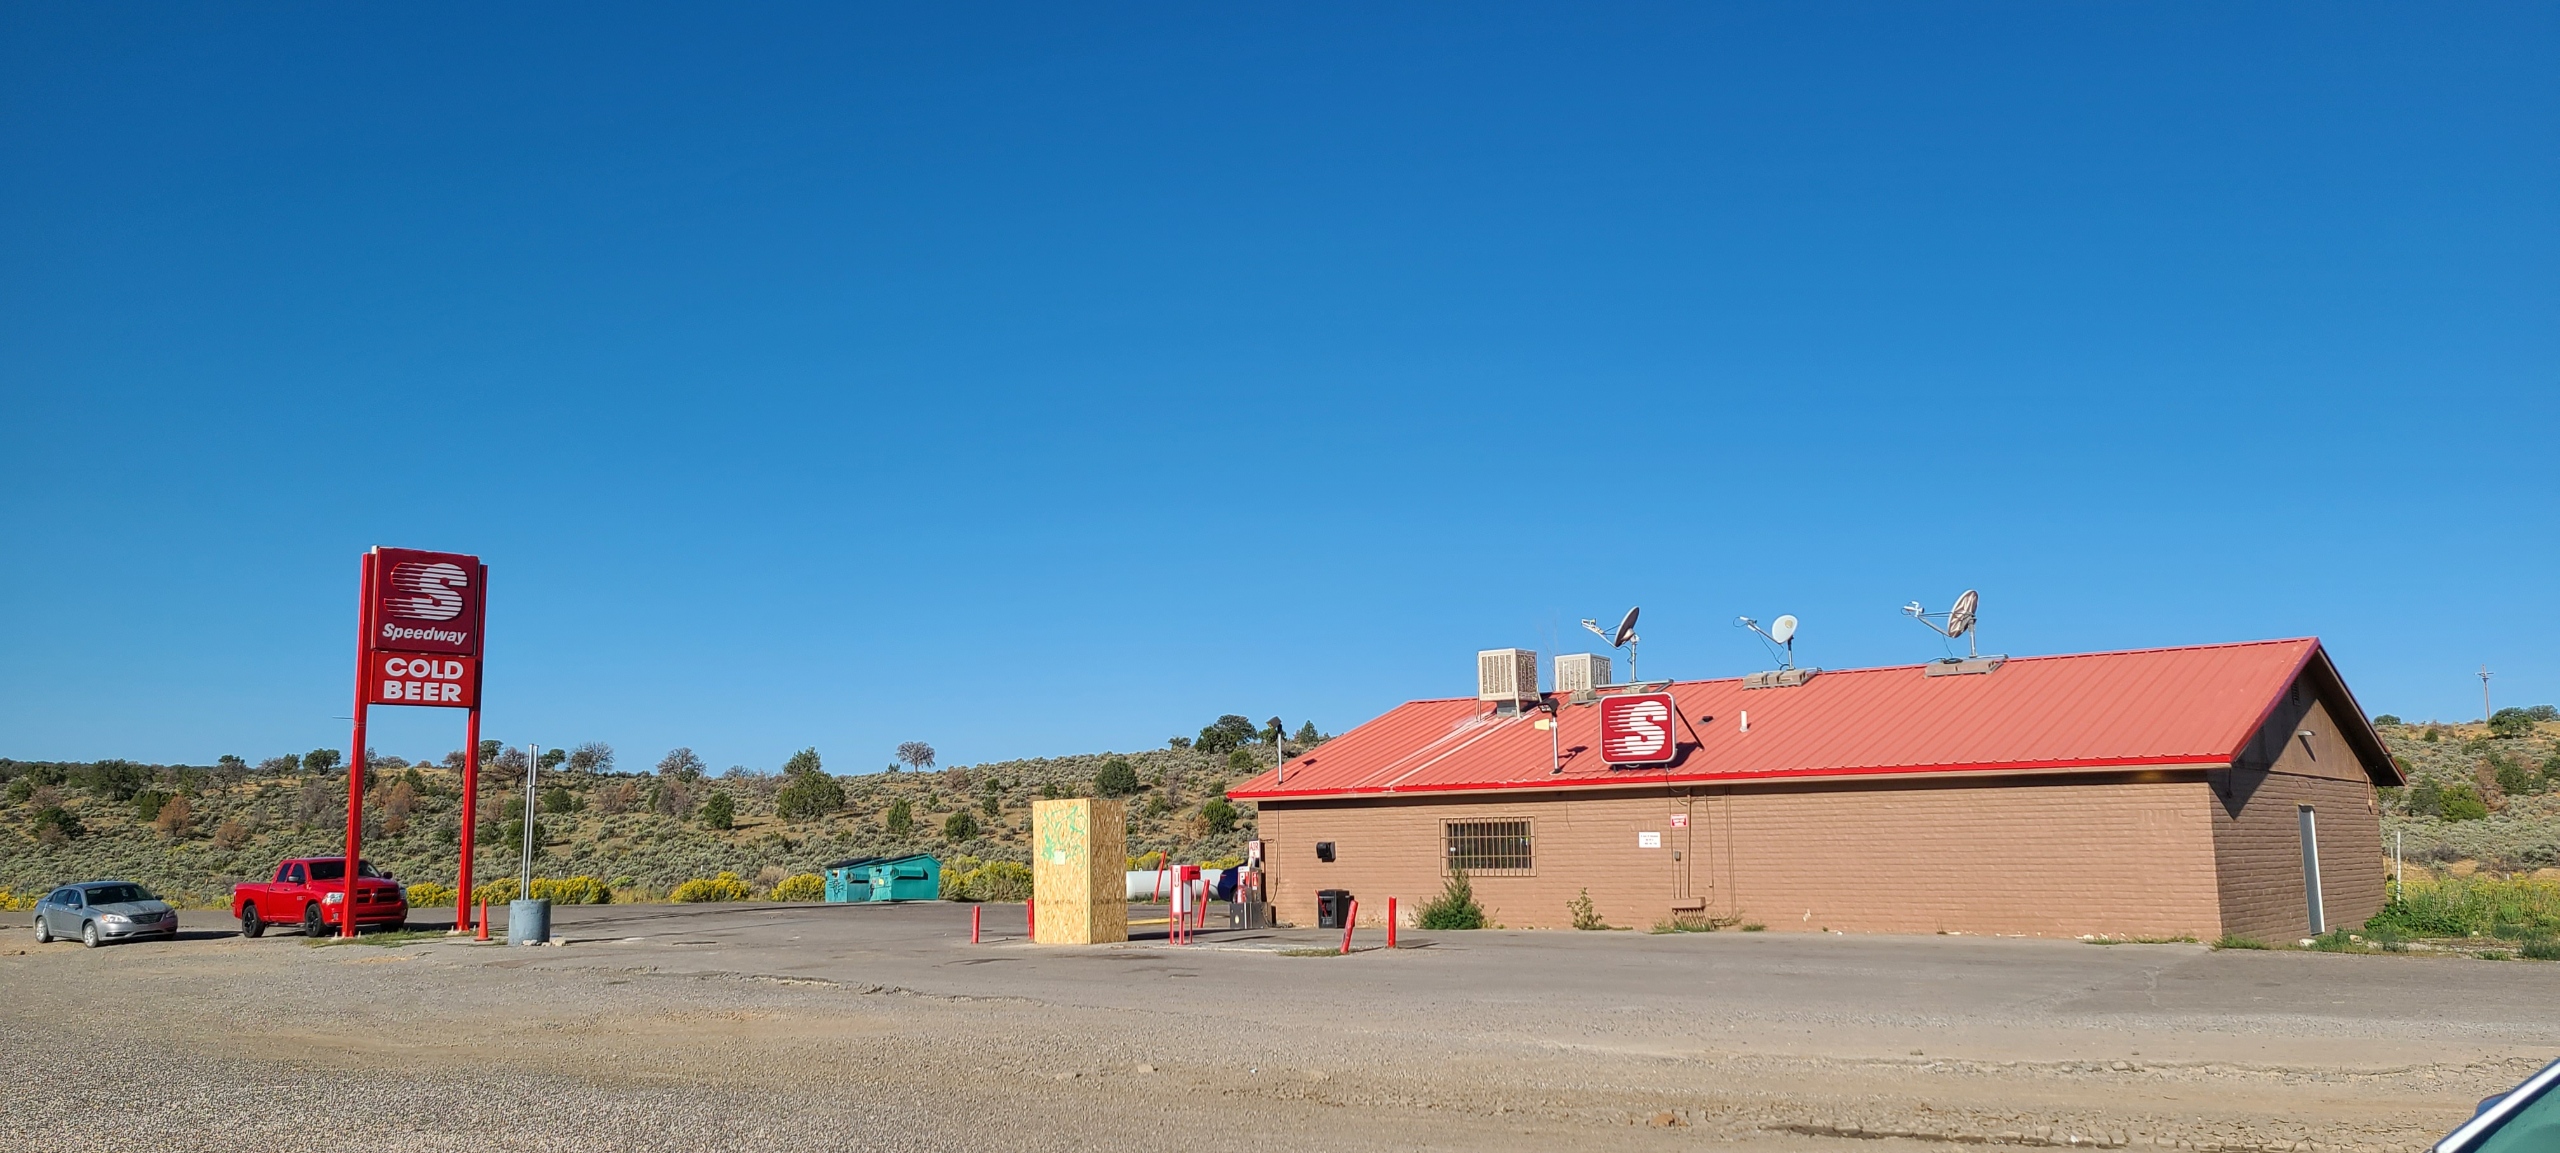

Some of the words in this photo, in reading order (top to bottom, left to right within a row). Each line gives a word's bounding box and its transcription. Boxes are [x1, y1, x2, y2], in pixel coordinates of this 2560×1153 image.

[384, 562, 467, 621] S
[382, 622, 467, 645] Speedway
[385, 657, 464, 680] COLD
[383, 680, 462, 702] BEER
[1604, 700, 1668, 757] S
